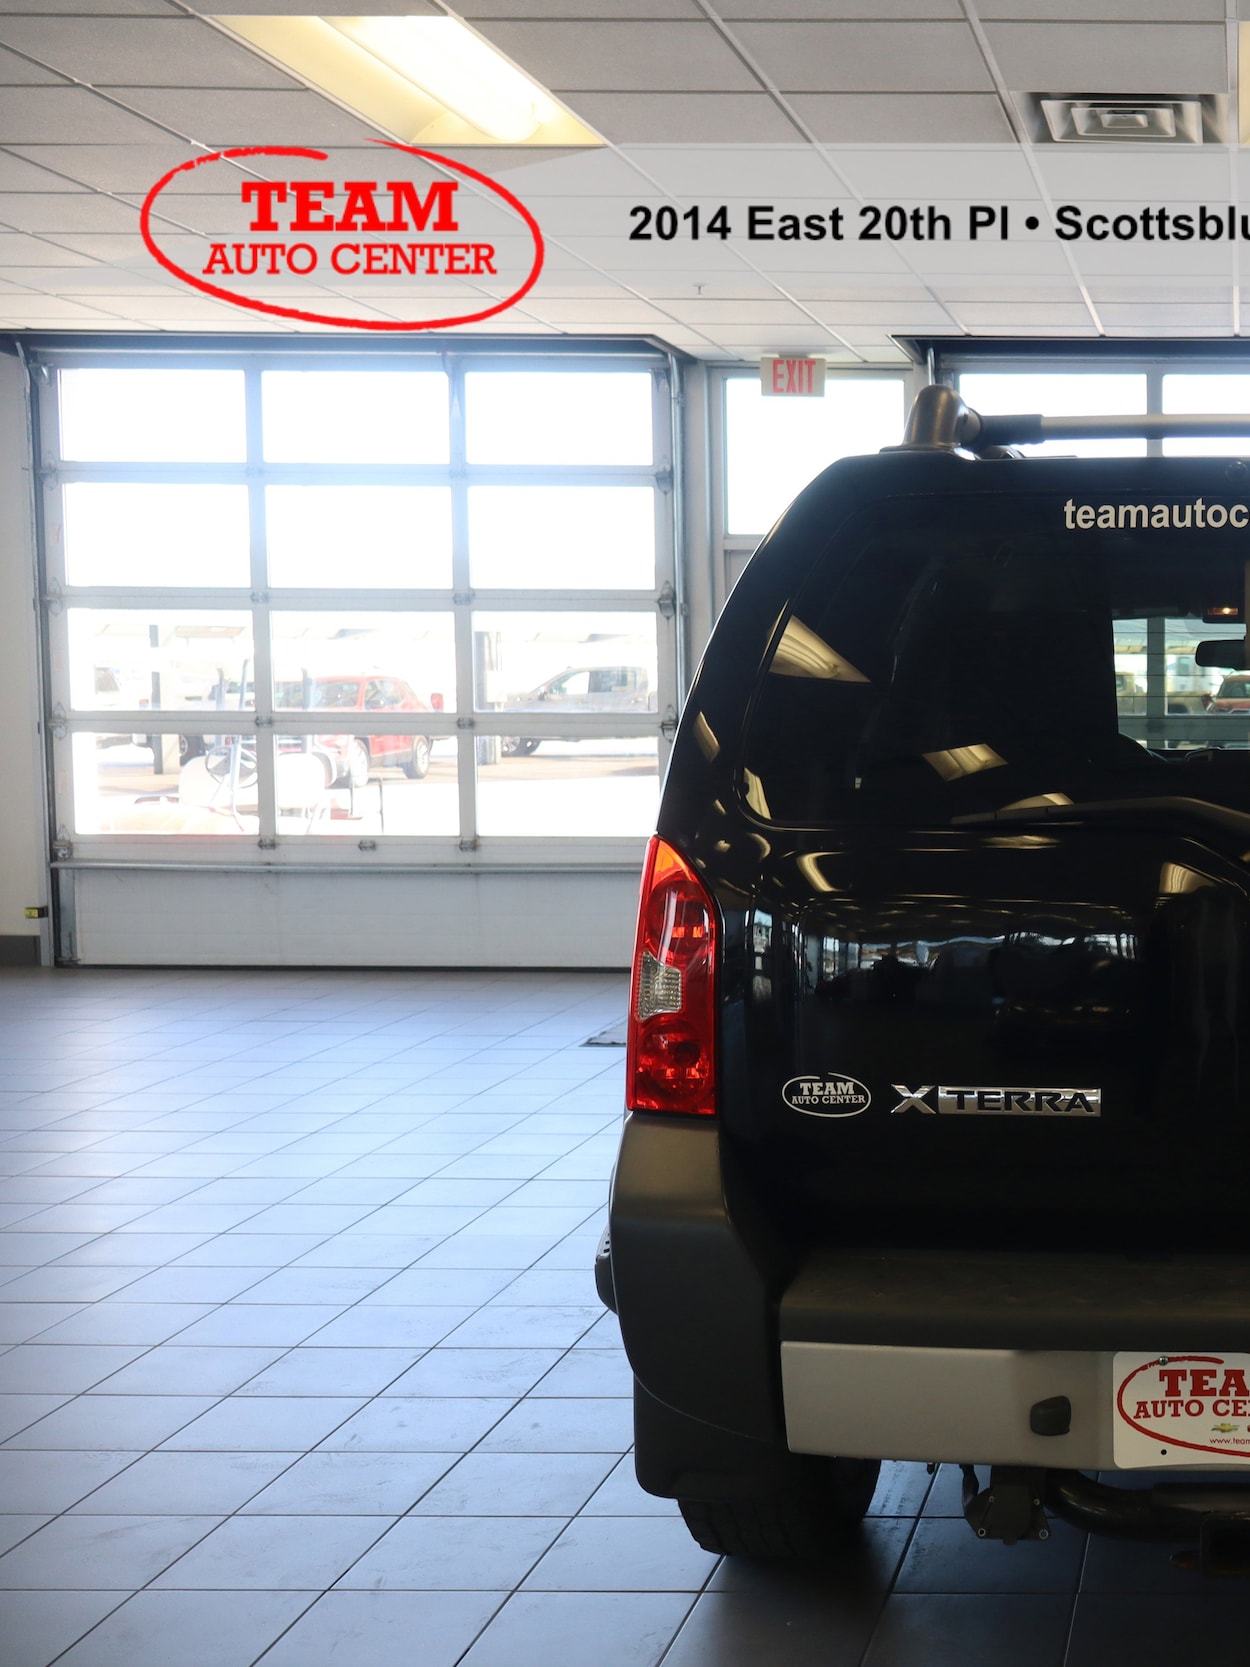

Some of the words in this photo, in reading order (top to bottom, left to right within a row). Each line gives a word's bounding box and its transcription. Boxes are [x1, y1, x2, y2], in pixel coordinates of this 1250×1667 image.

[772, 359, 816, 394] EXIT
[799, 1082, 855, 1096] TEAM
[791, 1095, 819, 1105] AUTO
[821, 1094, 867, 1105] CENTER
[1133, 1399, 1205, 1420] AUTO
